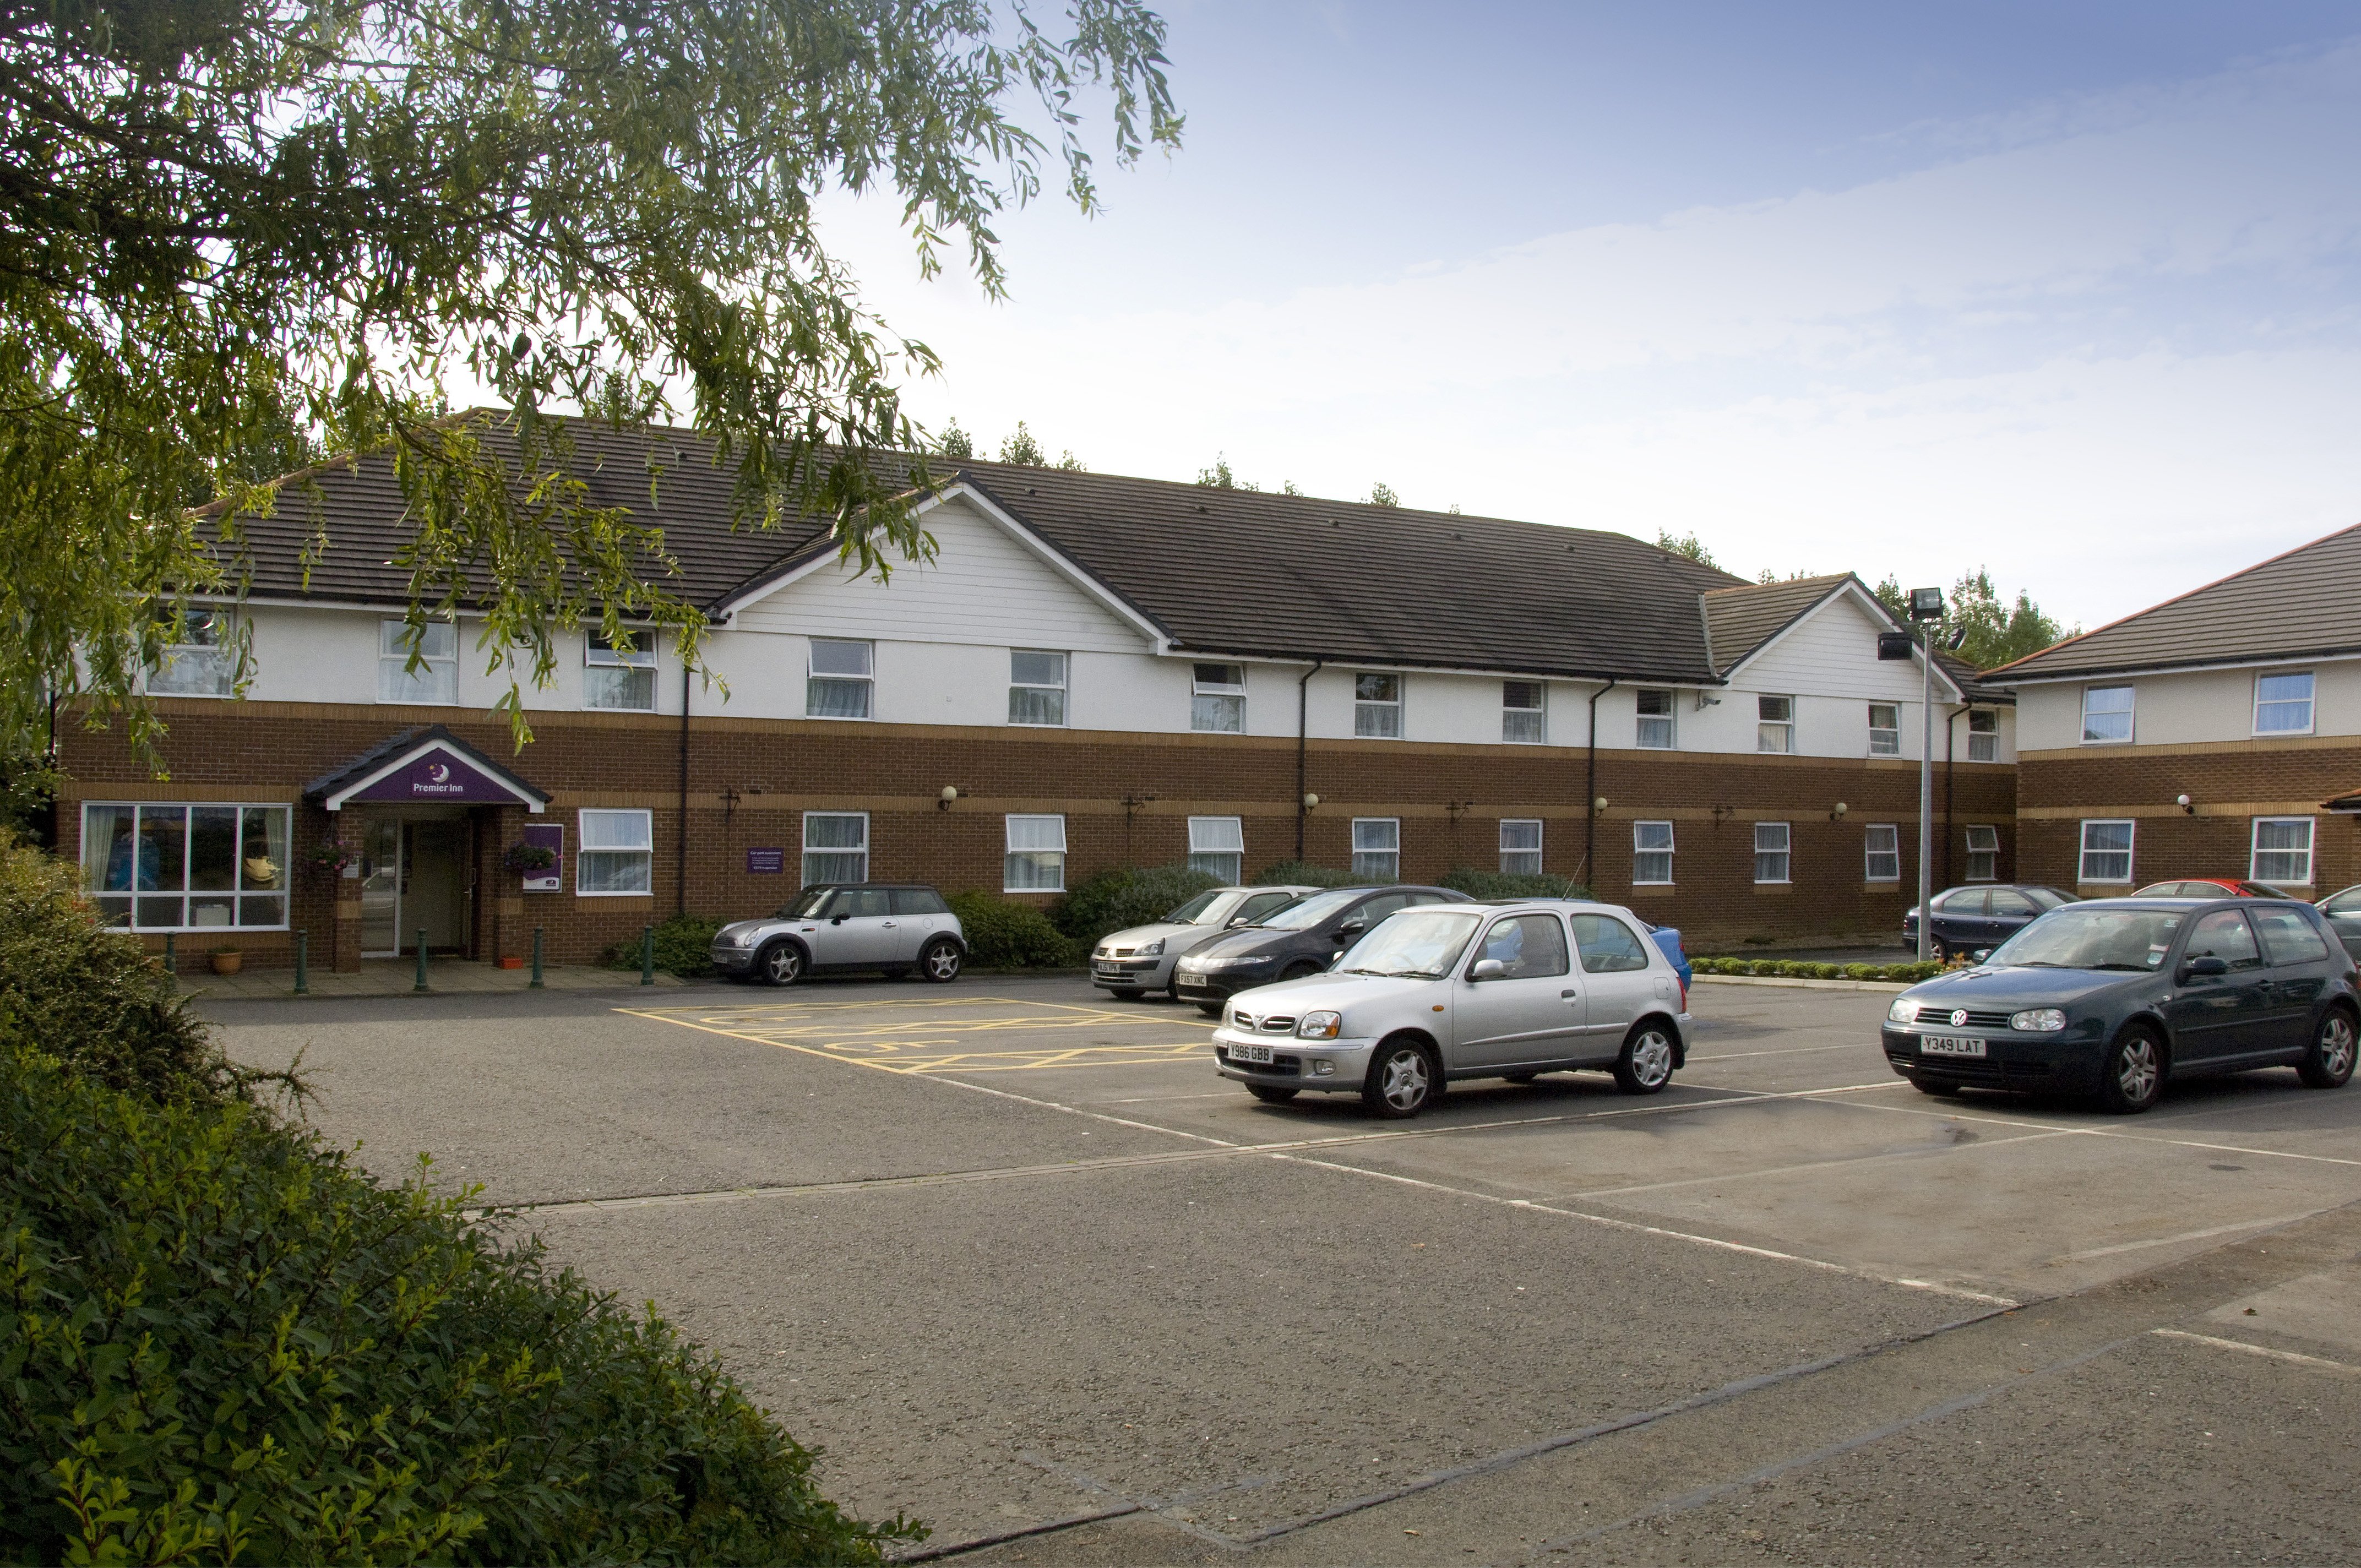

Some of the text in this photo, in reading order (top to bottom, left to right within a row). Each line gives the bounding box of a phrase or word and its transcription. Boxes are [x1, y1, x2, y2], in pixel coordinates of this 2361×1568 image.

[414, 783, 464, 792] Premier Inn
[1231, 1043, 1269, 1060] Y986 GBB
[1925, 1037, 1980, 1053] Y349 LAT
